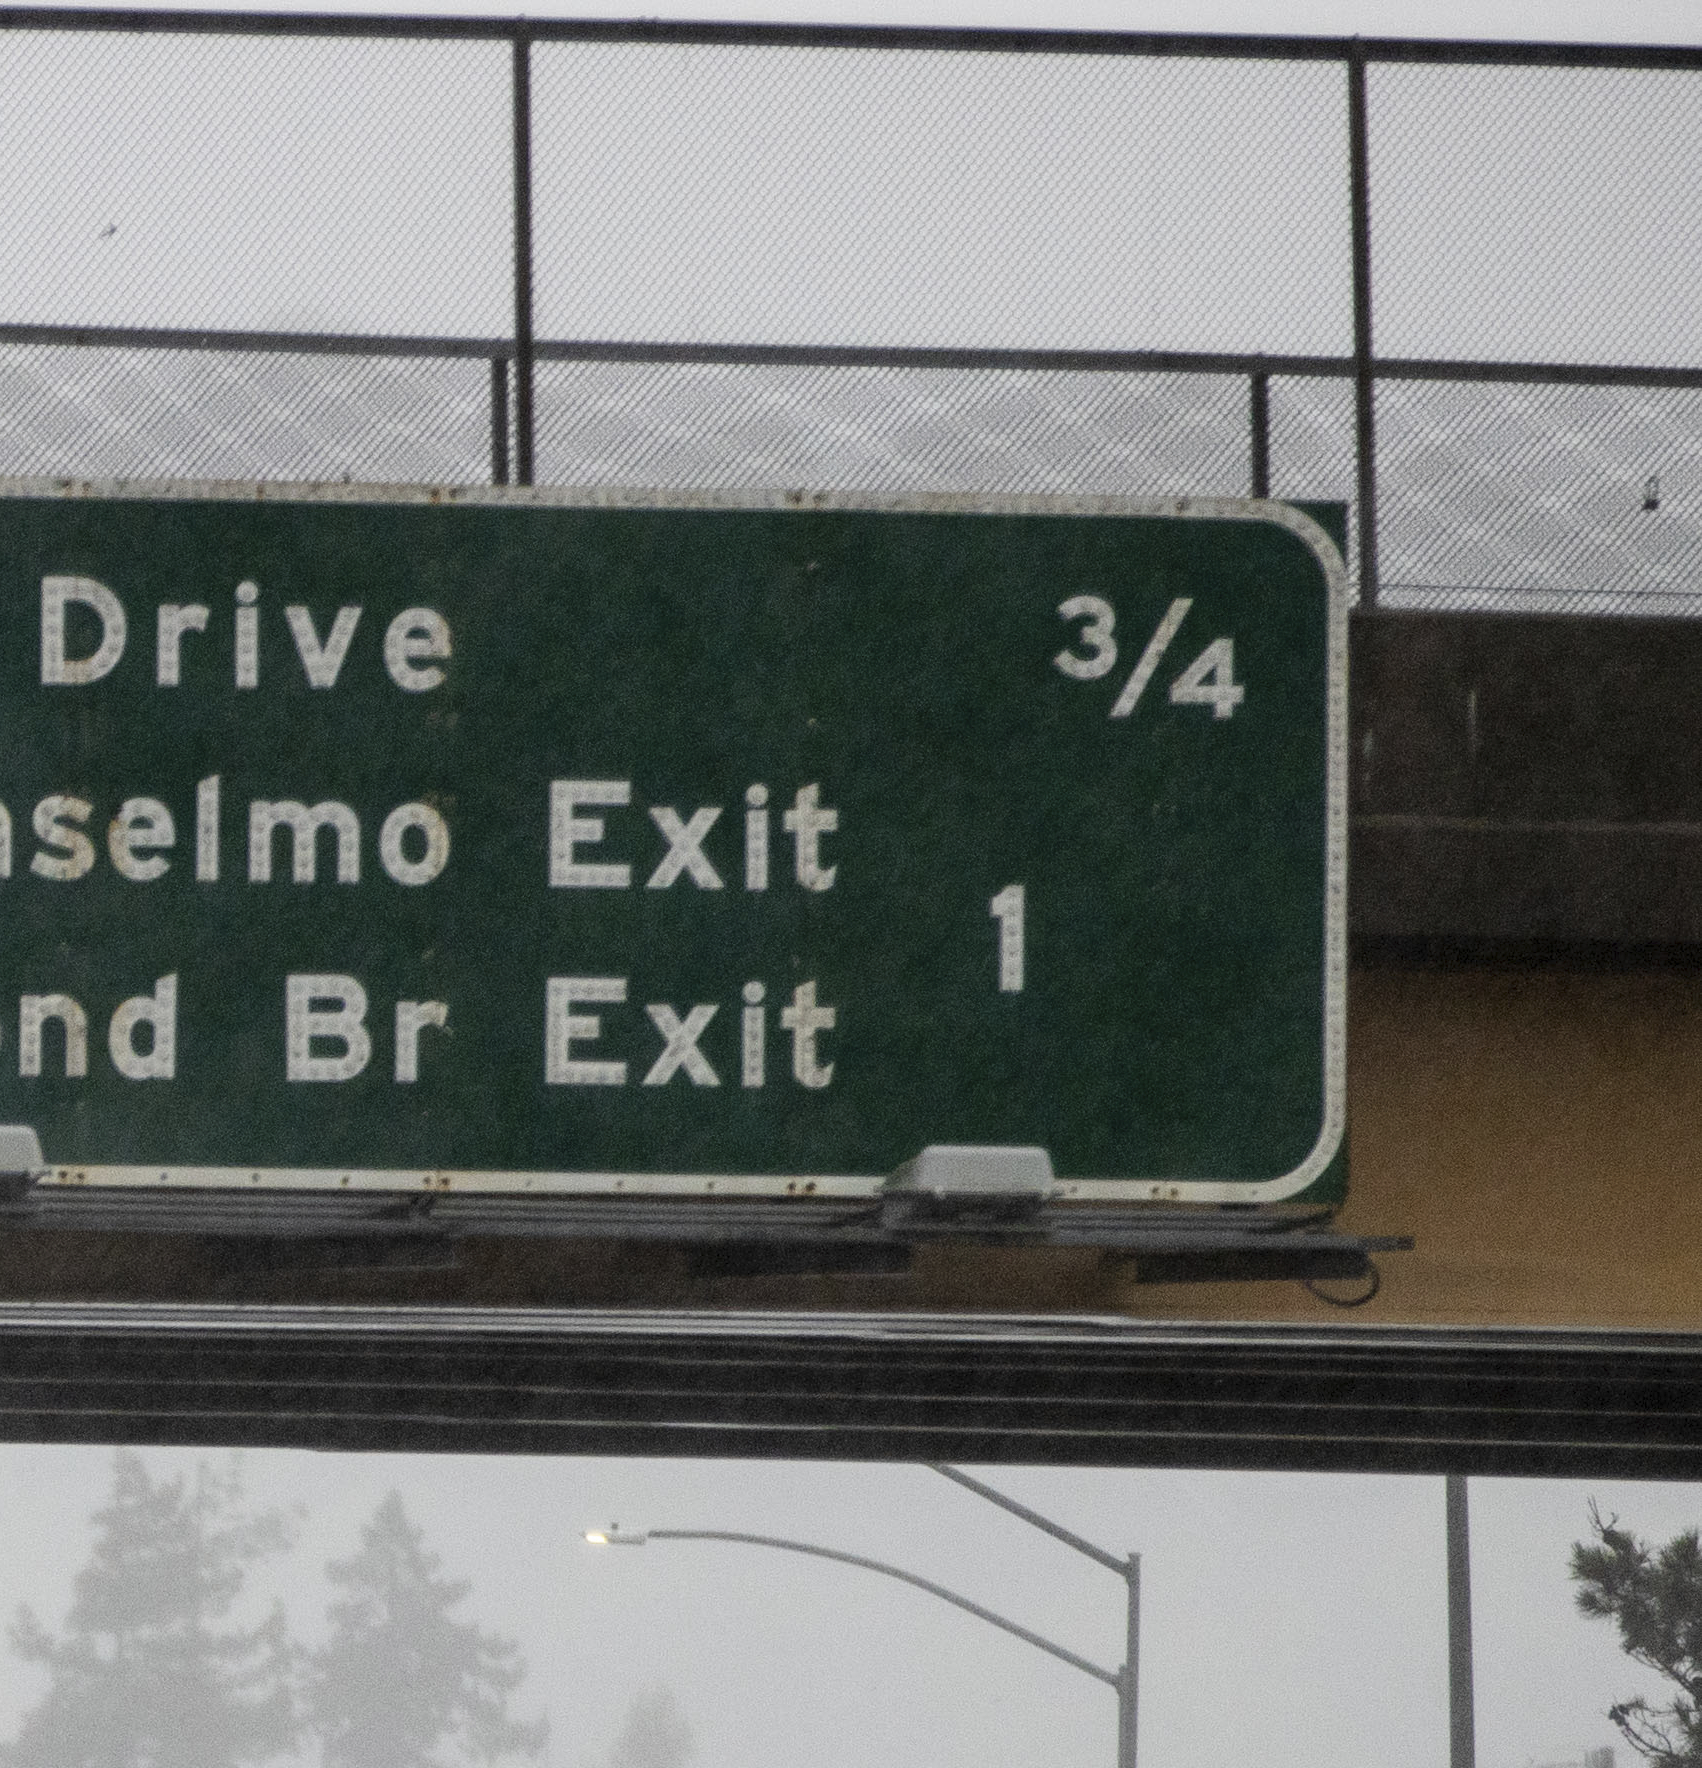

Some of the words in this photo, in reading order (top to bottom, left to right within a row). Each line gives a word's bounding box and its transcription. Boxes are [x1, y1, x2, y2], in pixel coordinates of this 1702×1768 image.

[40, 573, 453, 693] Drive
[1057, 594, 1244, 718] 3/4
[548, 777, 839, 892] Exit
[990, 883, 1026, 993] 1
[285, 972, 450, 1085] Br
[544, 974, 837, 1088] Exit
